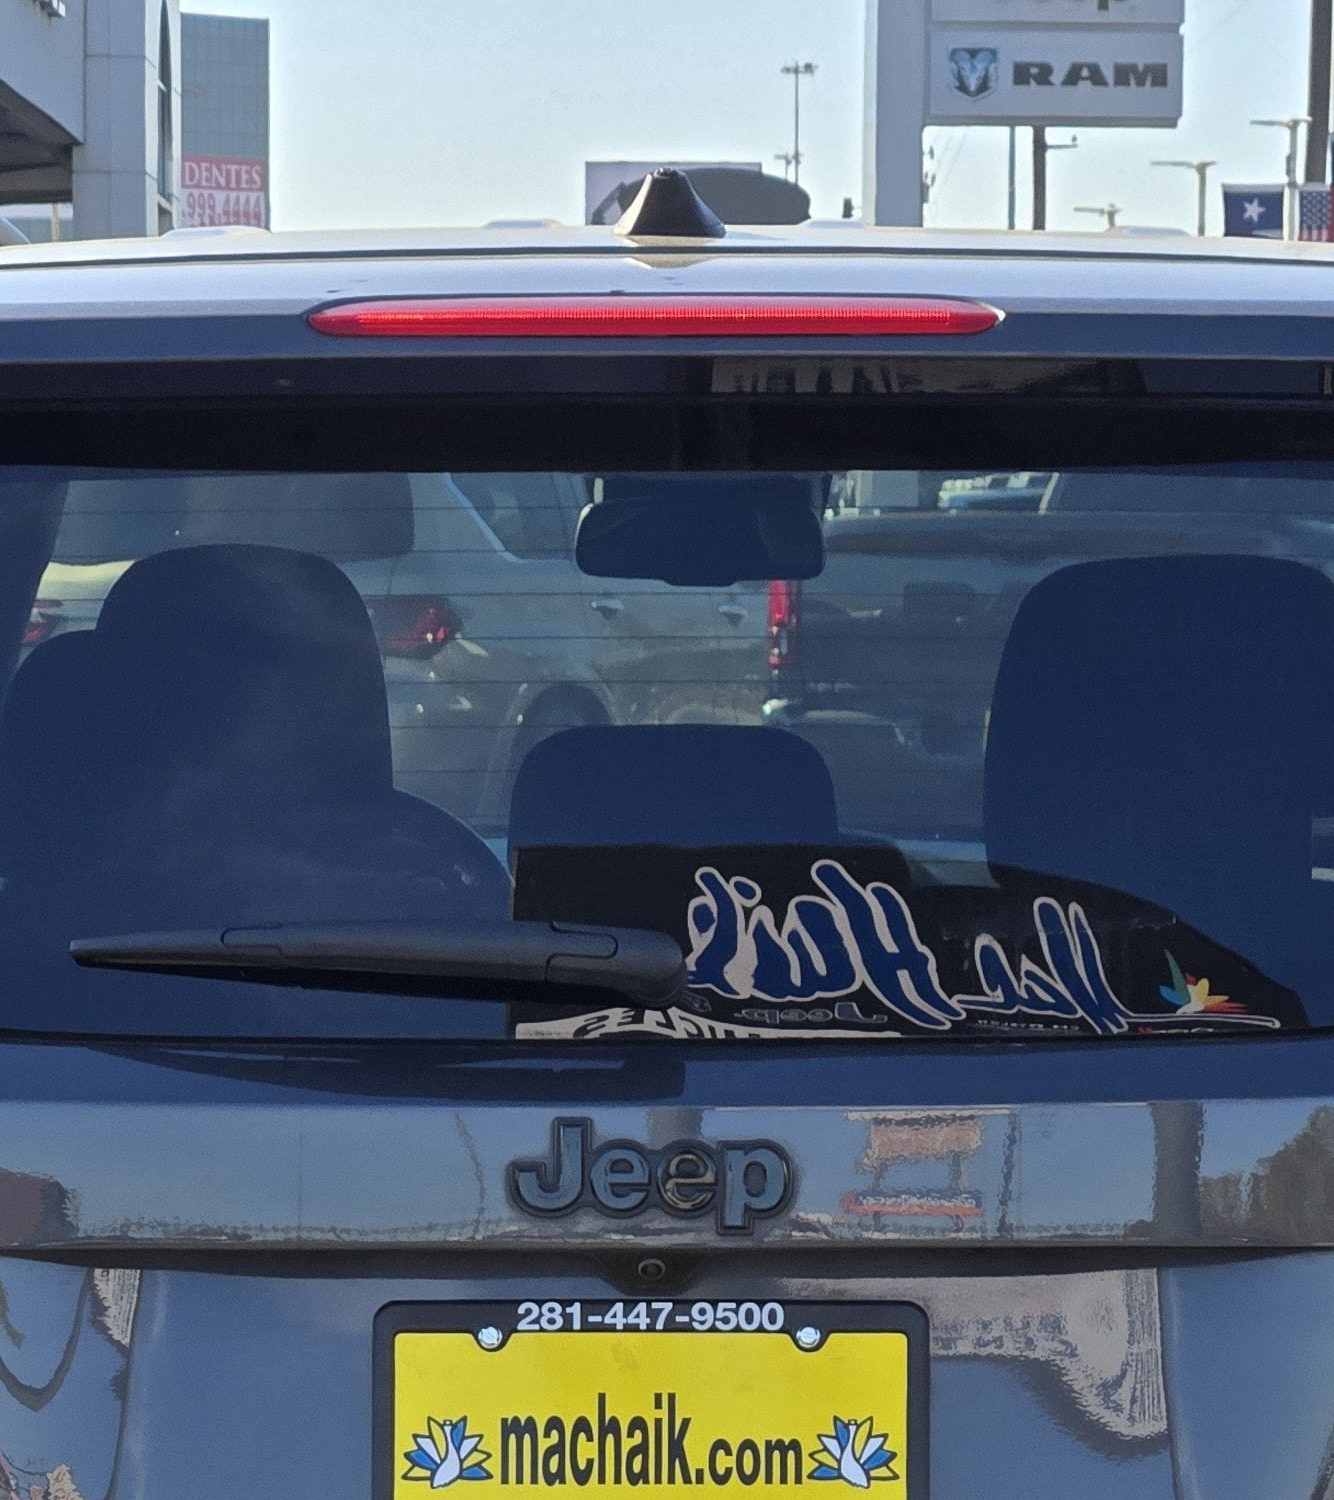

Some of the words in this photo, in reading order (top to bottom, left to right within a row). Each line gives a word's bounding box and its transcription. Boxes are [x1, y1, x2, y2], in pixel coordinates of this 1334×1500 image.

[1012, 61, 1169, 88] RAM
[184, 161, 263, 189] DENTES
[506, 1116, 795, 1237] Jeep
[516, 1301, 786, 1332] 281-447-9500
[499, 1392, 804, 1486] machaik.com
